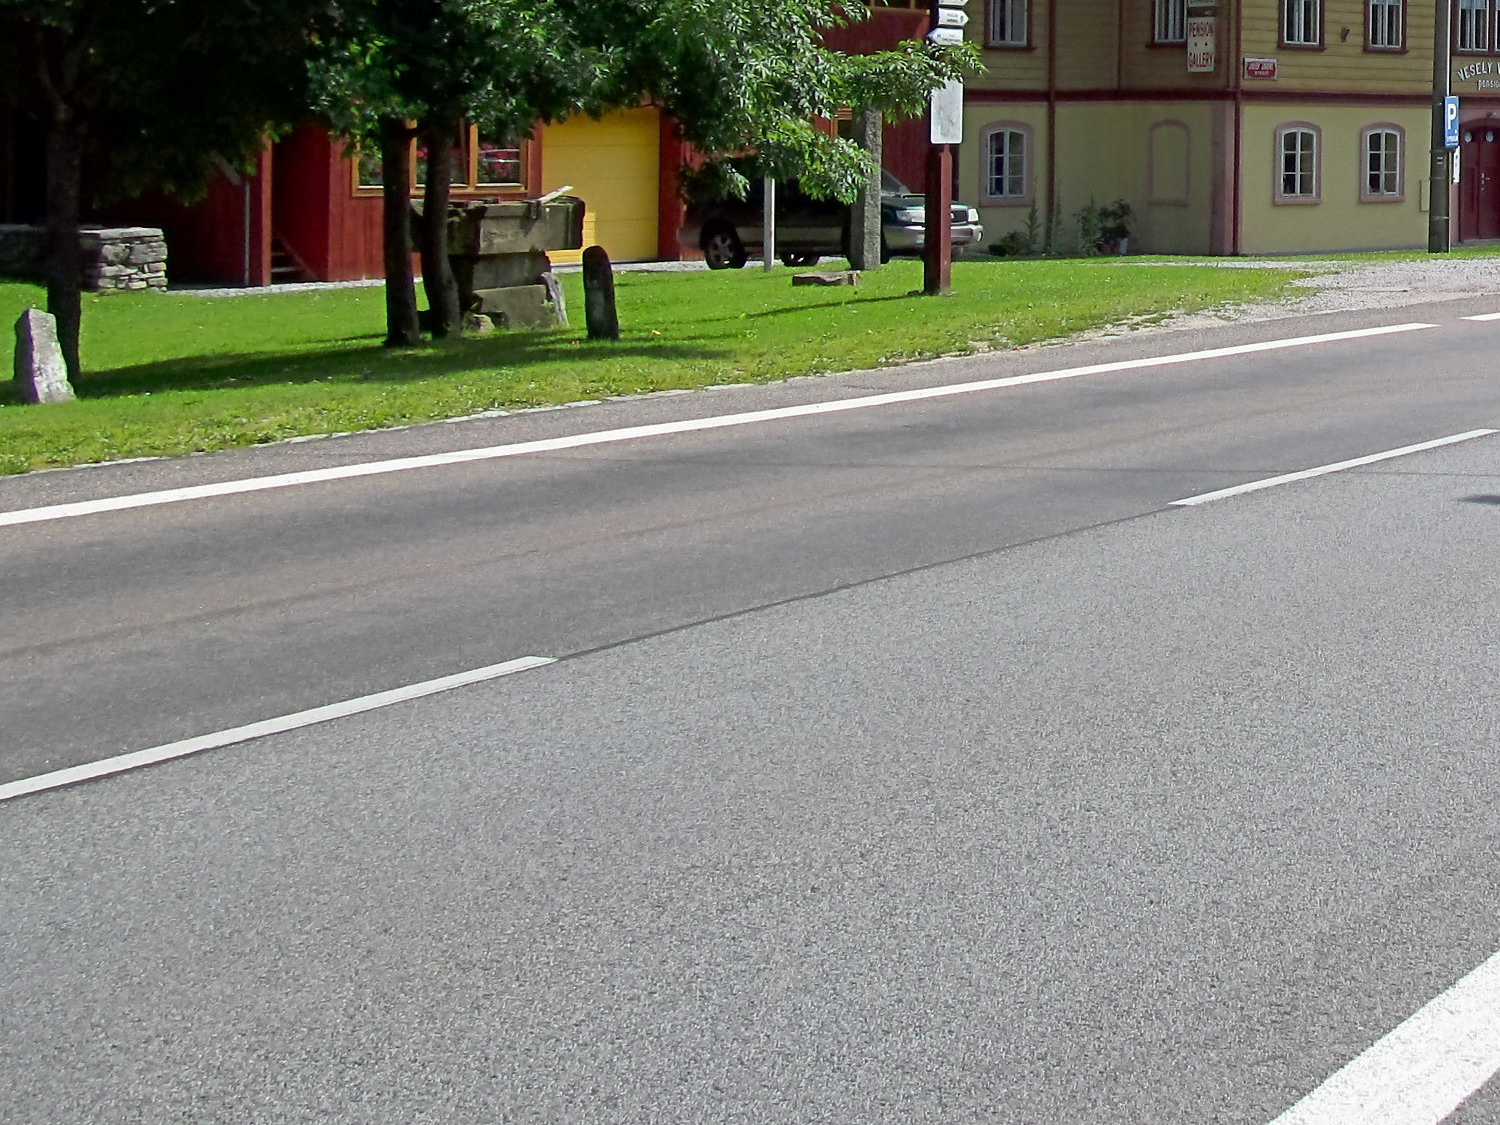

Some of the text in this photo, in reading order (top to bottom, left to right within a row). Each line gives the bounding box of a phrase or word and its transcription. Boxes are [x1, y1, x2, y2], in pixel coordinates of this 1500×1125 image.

[1189, 22, 1214, 37] PENSION
[1189, 53, 1213, 68] GALLERY
[1447, 103, 1457, 130] P
